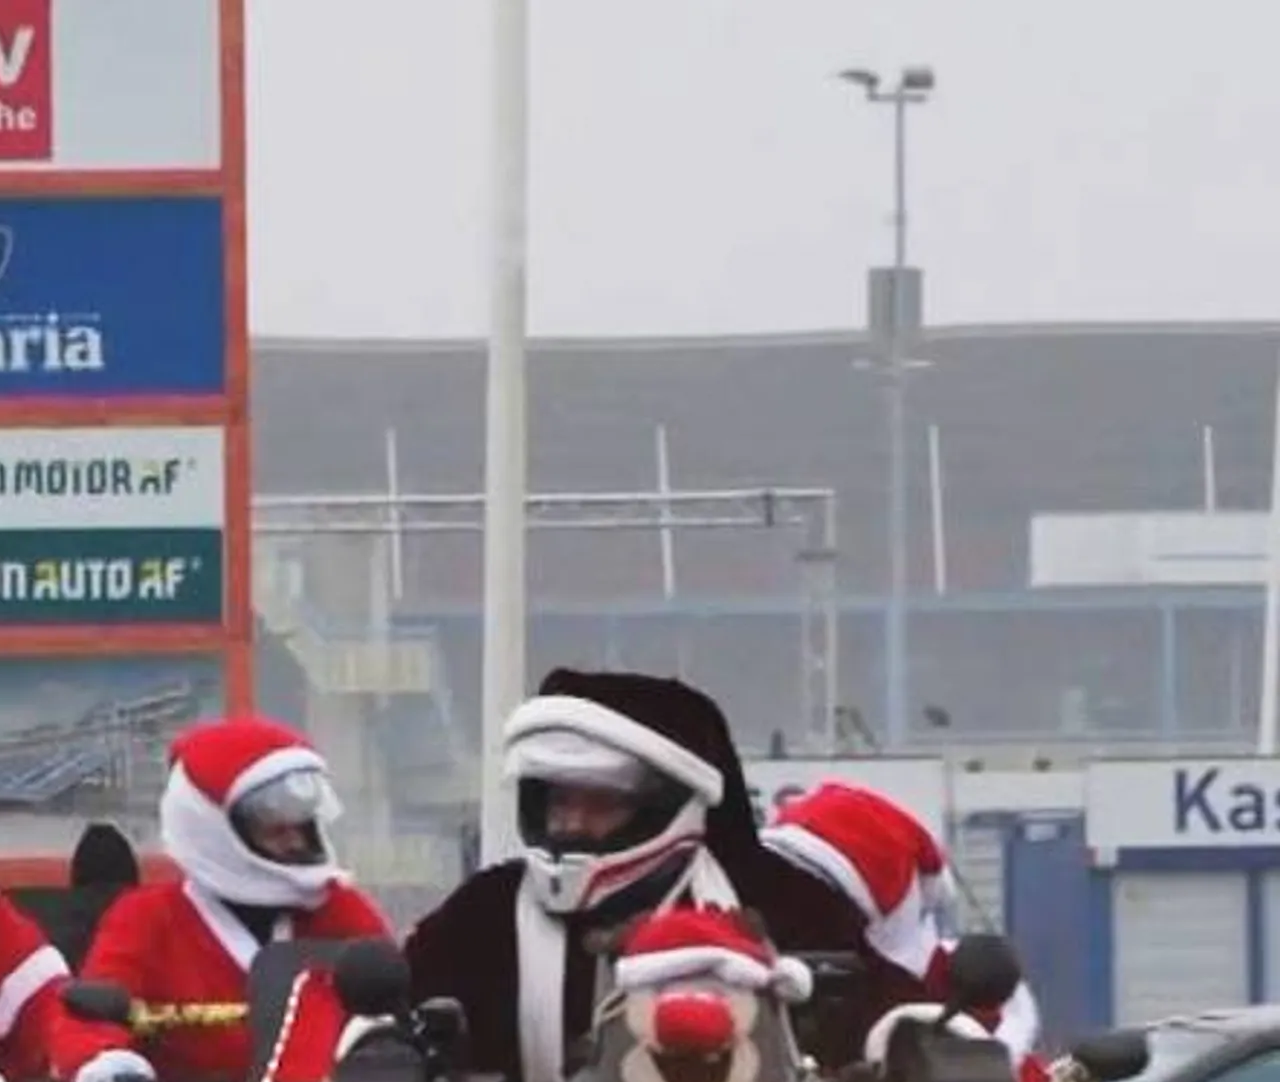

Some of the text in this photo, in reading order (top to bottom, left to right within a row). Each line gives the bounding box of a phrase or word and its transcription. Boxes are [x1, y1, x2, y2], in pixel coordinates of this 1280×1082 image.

[14, 458, 133, 496] MOTOR
[32, 557, 133, 602] AUTO
[1174, 767, 1280, 834] Ka
